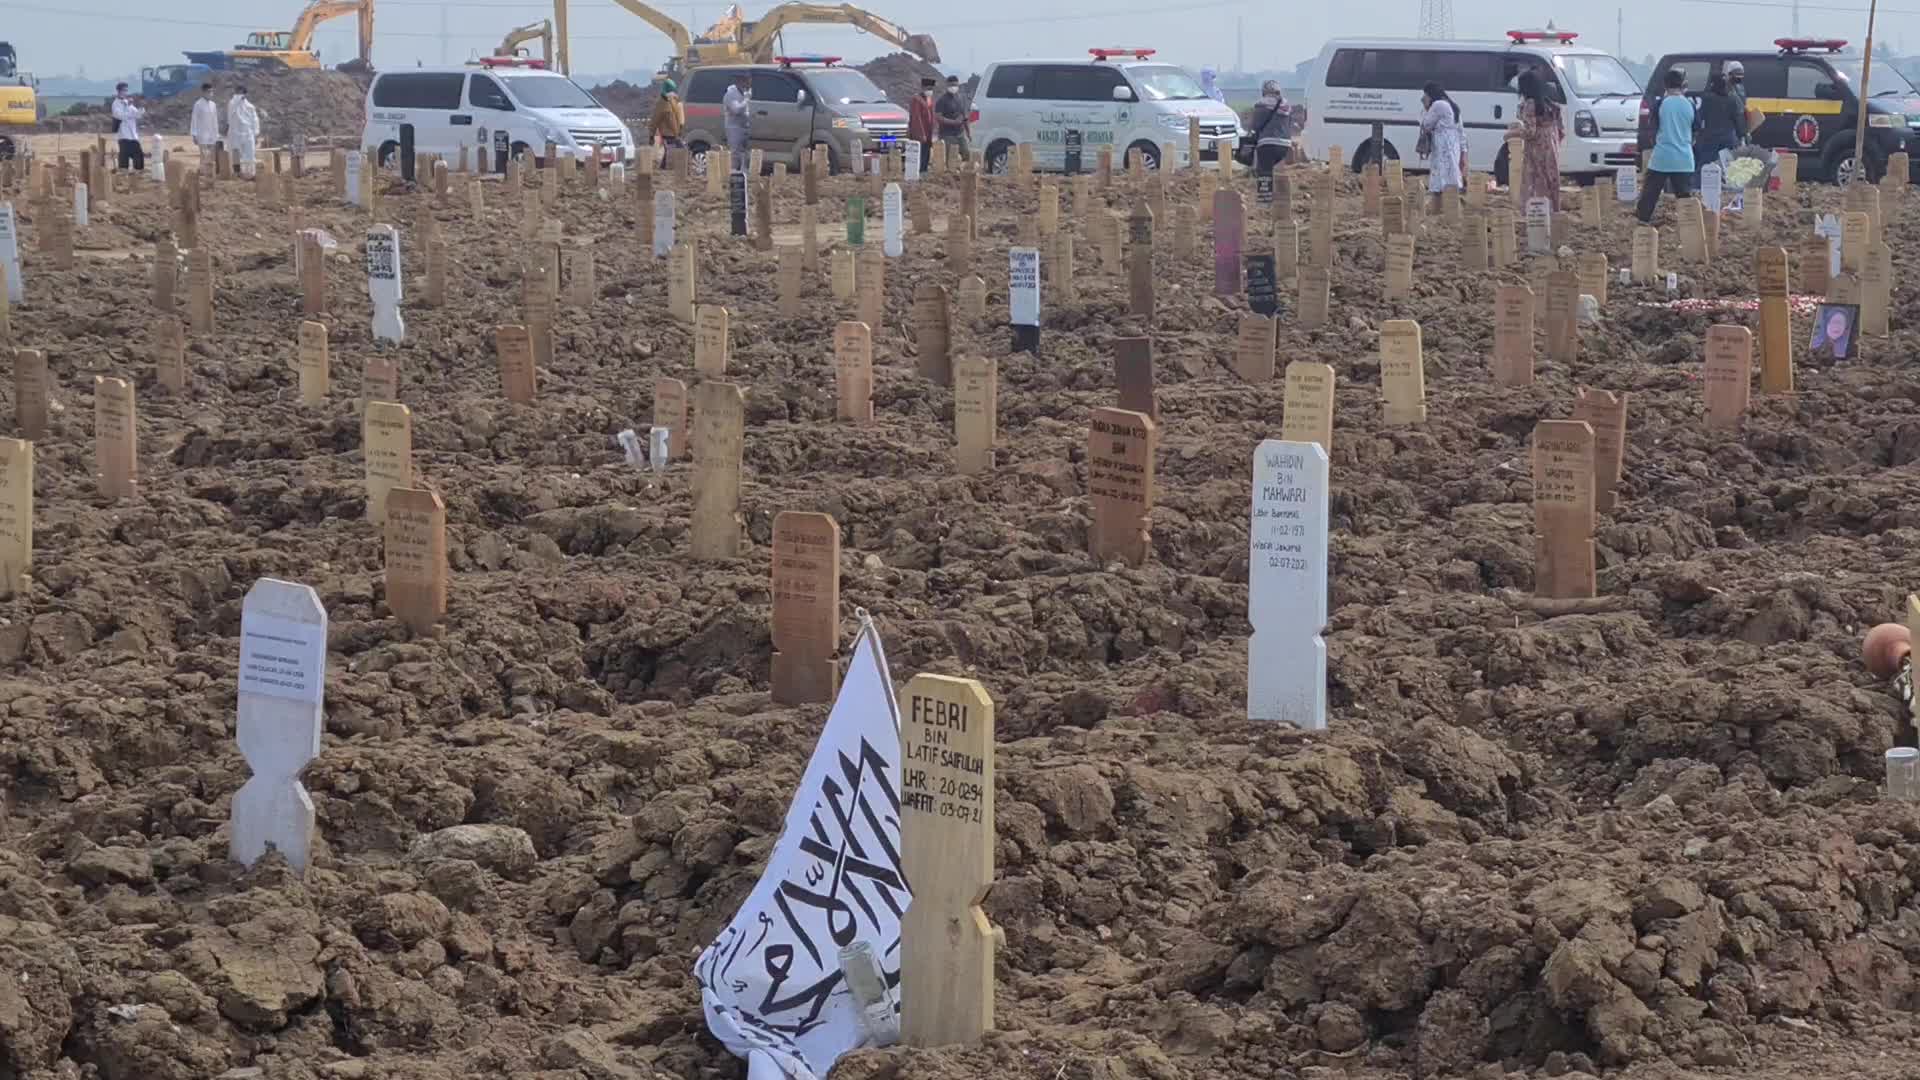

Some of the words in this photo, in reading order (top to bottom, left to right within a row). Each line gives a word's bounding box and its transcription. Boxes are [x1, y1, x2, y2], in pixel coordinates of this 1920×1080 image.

[911, 695, 968, 733] FEBRI
[924, 727, 948, 746] BIN
[906, 741, 939, 764] LATIF
[903, 767, 928, 791] LHR
